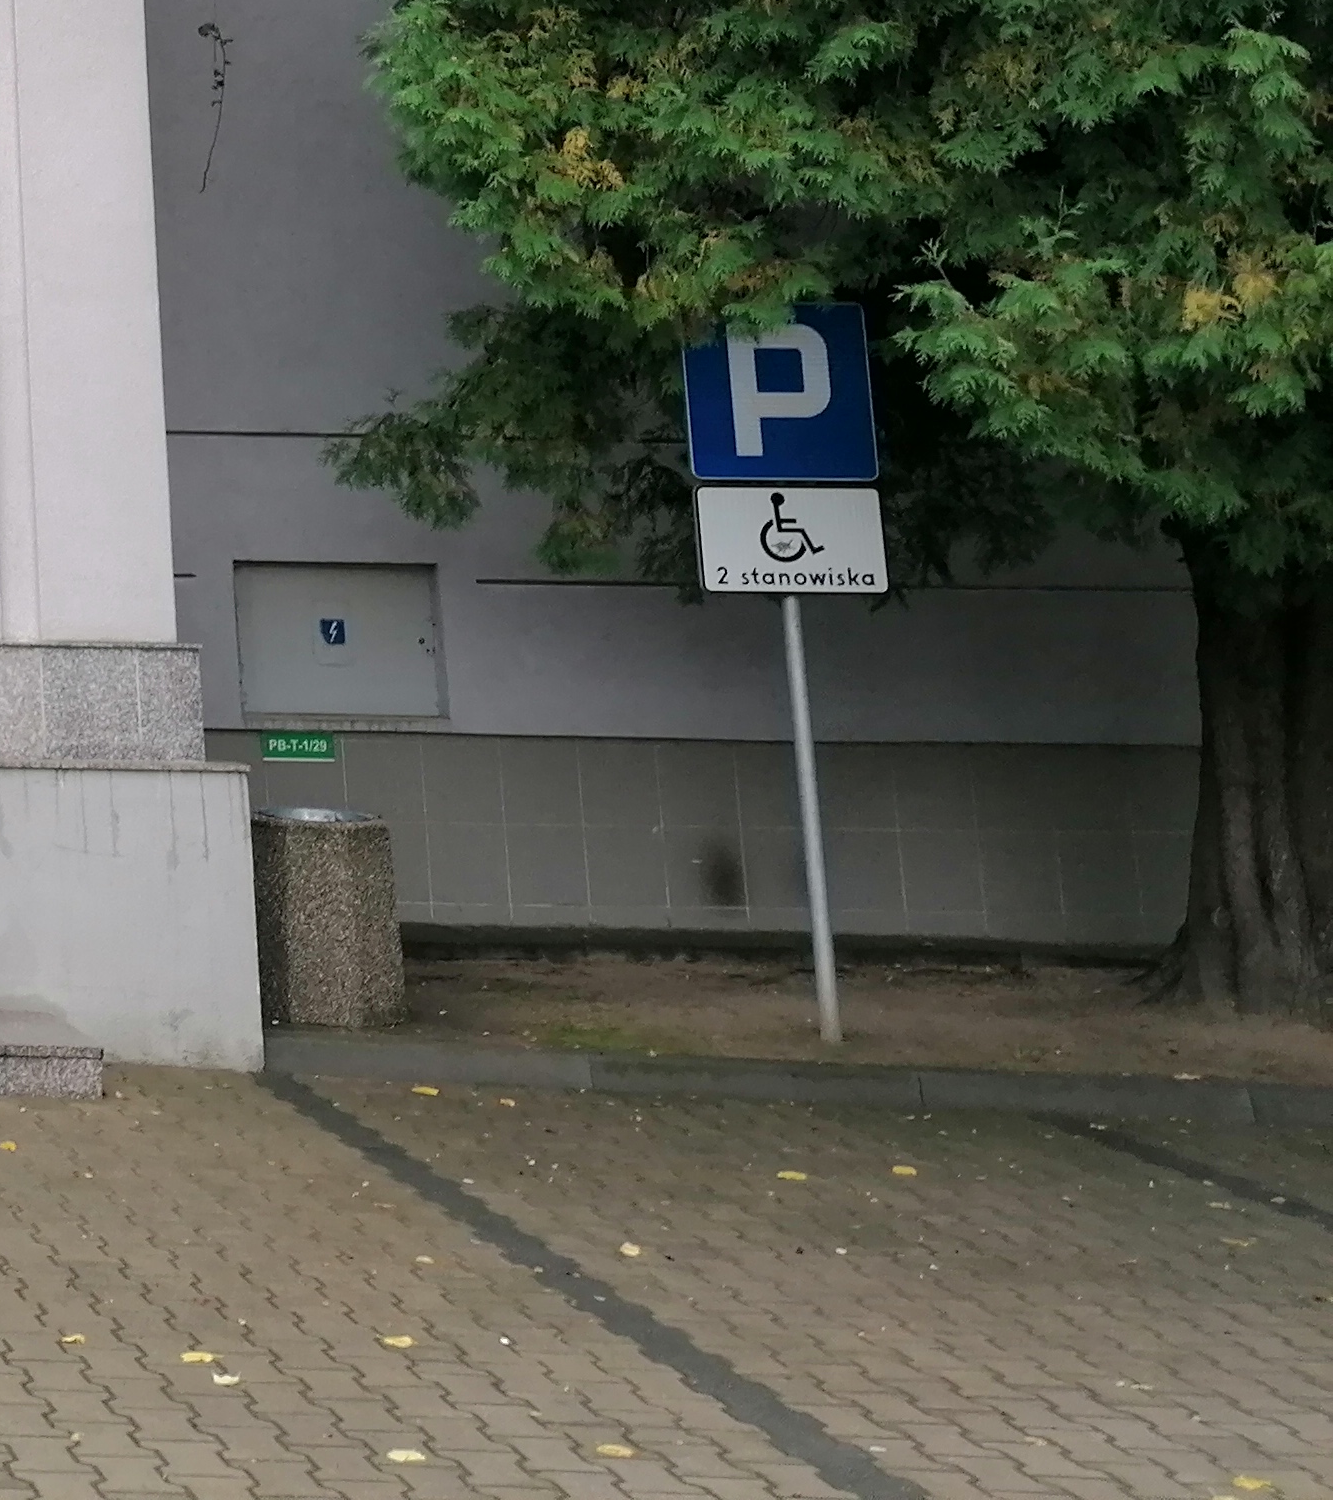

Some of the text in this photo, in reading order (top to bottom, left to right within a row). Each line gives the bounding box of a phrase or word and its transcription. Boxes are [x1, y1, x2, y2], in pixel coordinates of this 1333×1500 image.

[726, 322, 832, 457] P
[717, 566, 876, 587] 2 stanowiska
[268, 738, 328, 753] PB-T-1/29
